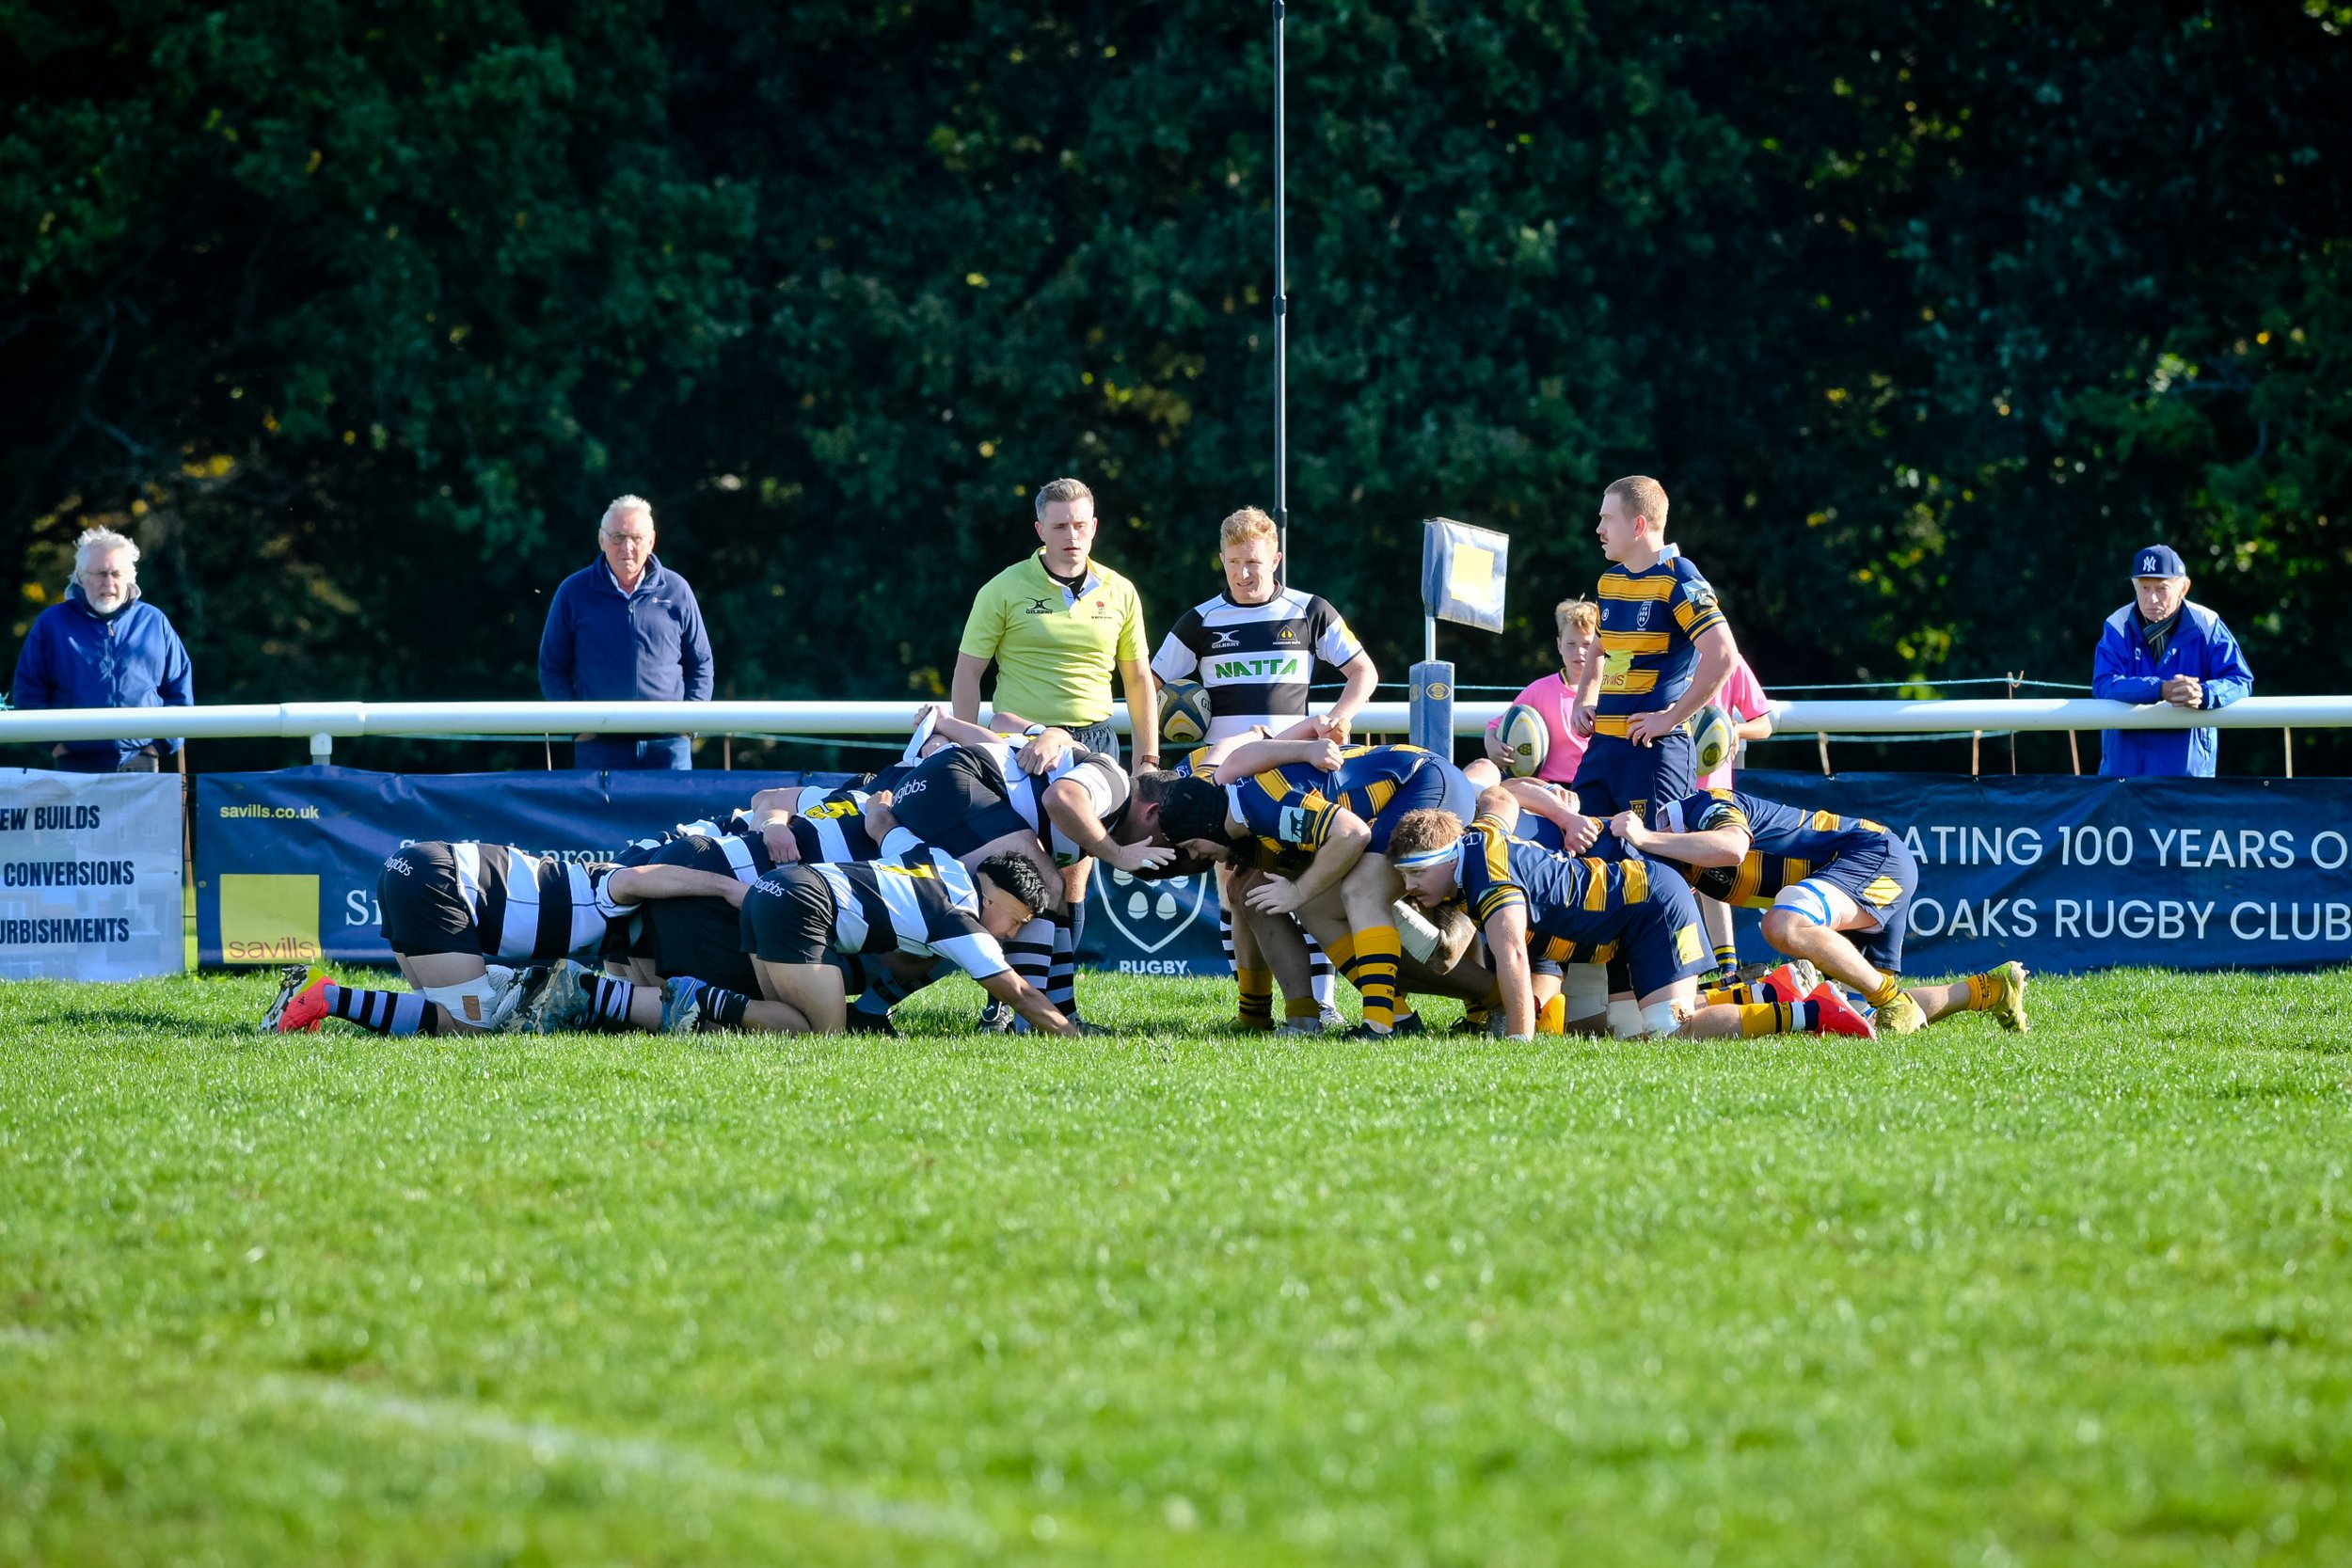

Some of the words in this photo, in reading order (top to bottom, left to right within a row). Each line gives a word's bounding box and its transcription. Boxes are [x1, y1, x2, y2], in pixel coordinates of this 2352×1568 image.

[1215, 658, 1297, 679] NATTA
[0, 807, 28, 831] EW
[34, 804, 101, 831] BUILDS
[219, 804, 319, 818] savills.co.uk
[1904, 826, 2043, 865] ATING
[2058, 826, 2134, 865] 100
[2149, 829, 2296, 869] YEARS
[4, 860, 135, 887] CONVERSIONS
[1908, 897, 2038, 938] OAKS
[2055, 899, 2215, 939] RUGBY
[2230, 901, 2352, 941] CLUB
[229, 937, 315, 958] savills
[1119, 960, 1188, 974] RUGBY
